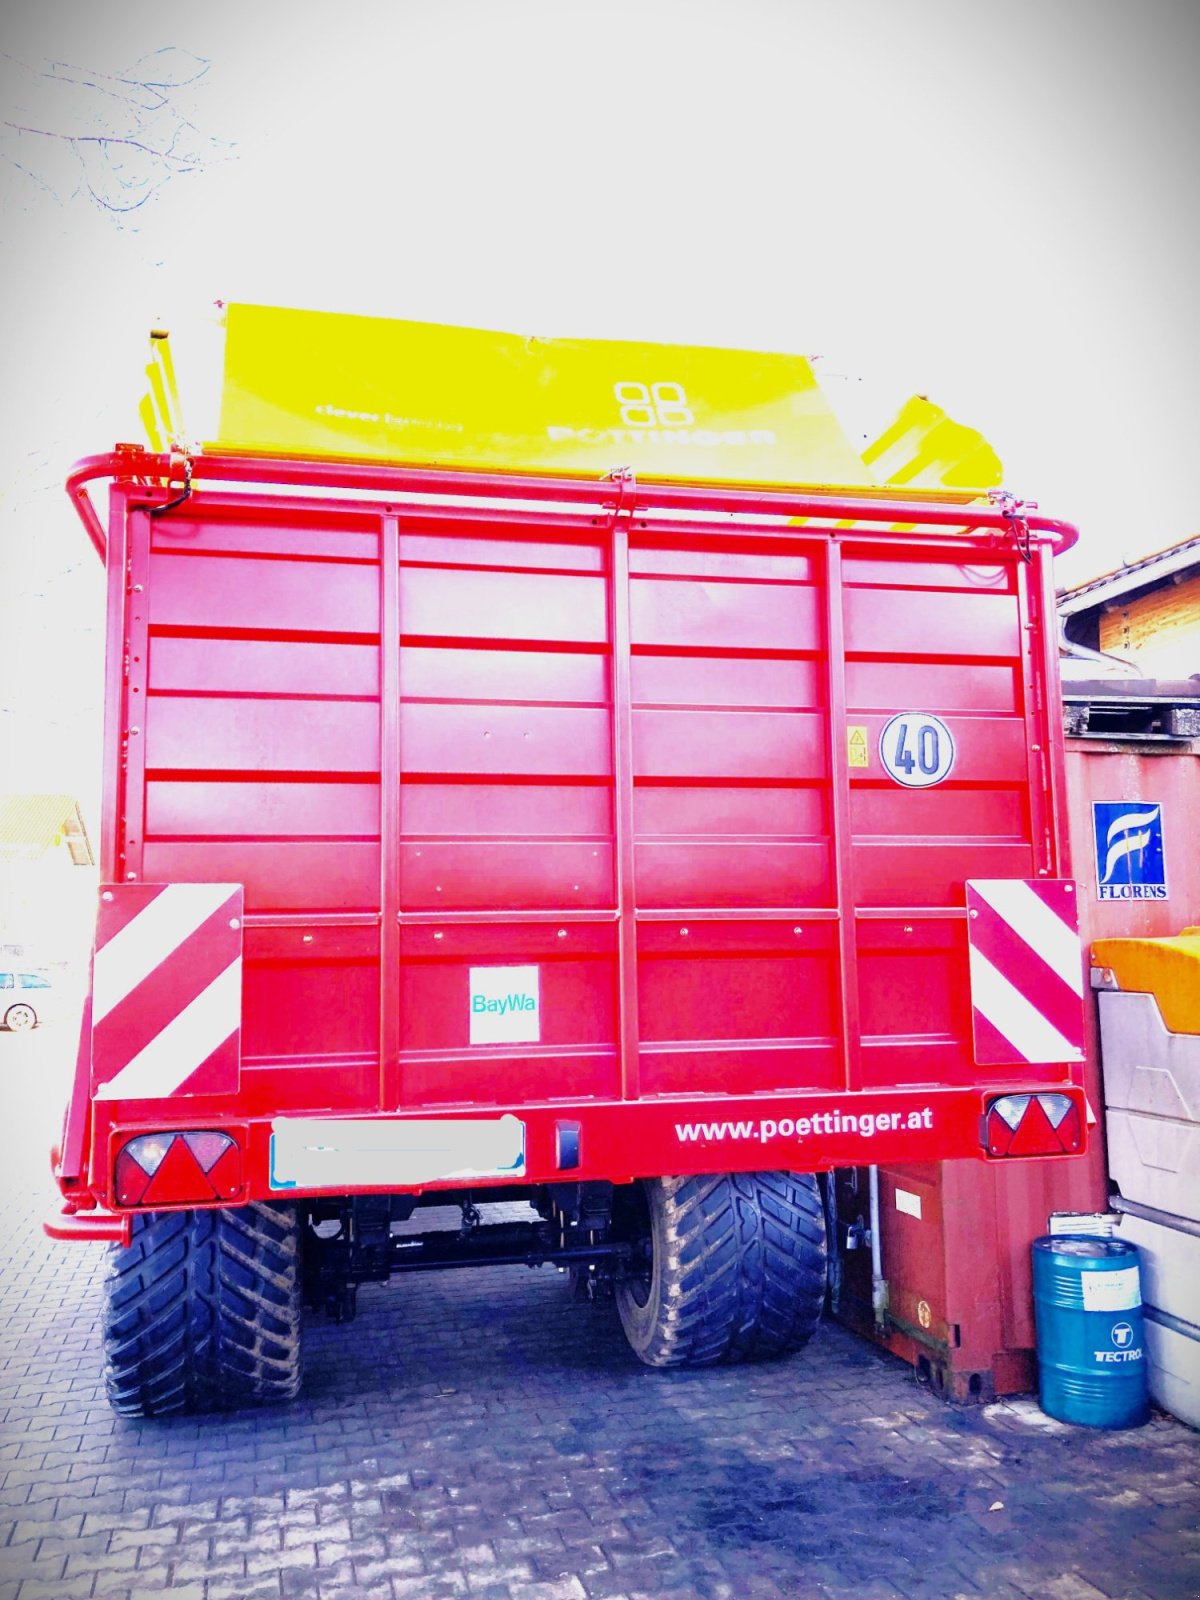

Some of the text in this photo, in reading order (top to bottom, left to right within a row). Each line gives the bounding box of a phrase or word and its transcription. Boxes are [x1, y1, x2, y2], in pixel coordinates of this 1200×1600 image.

[895, 723, 939, 775] 40
[1099, 885, 1167, 899] FLORENS
[472, 993, 536, 1015] BayWa
[675, 1107, 934, 1143] www.poettinger.at
